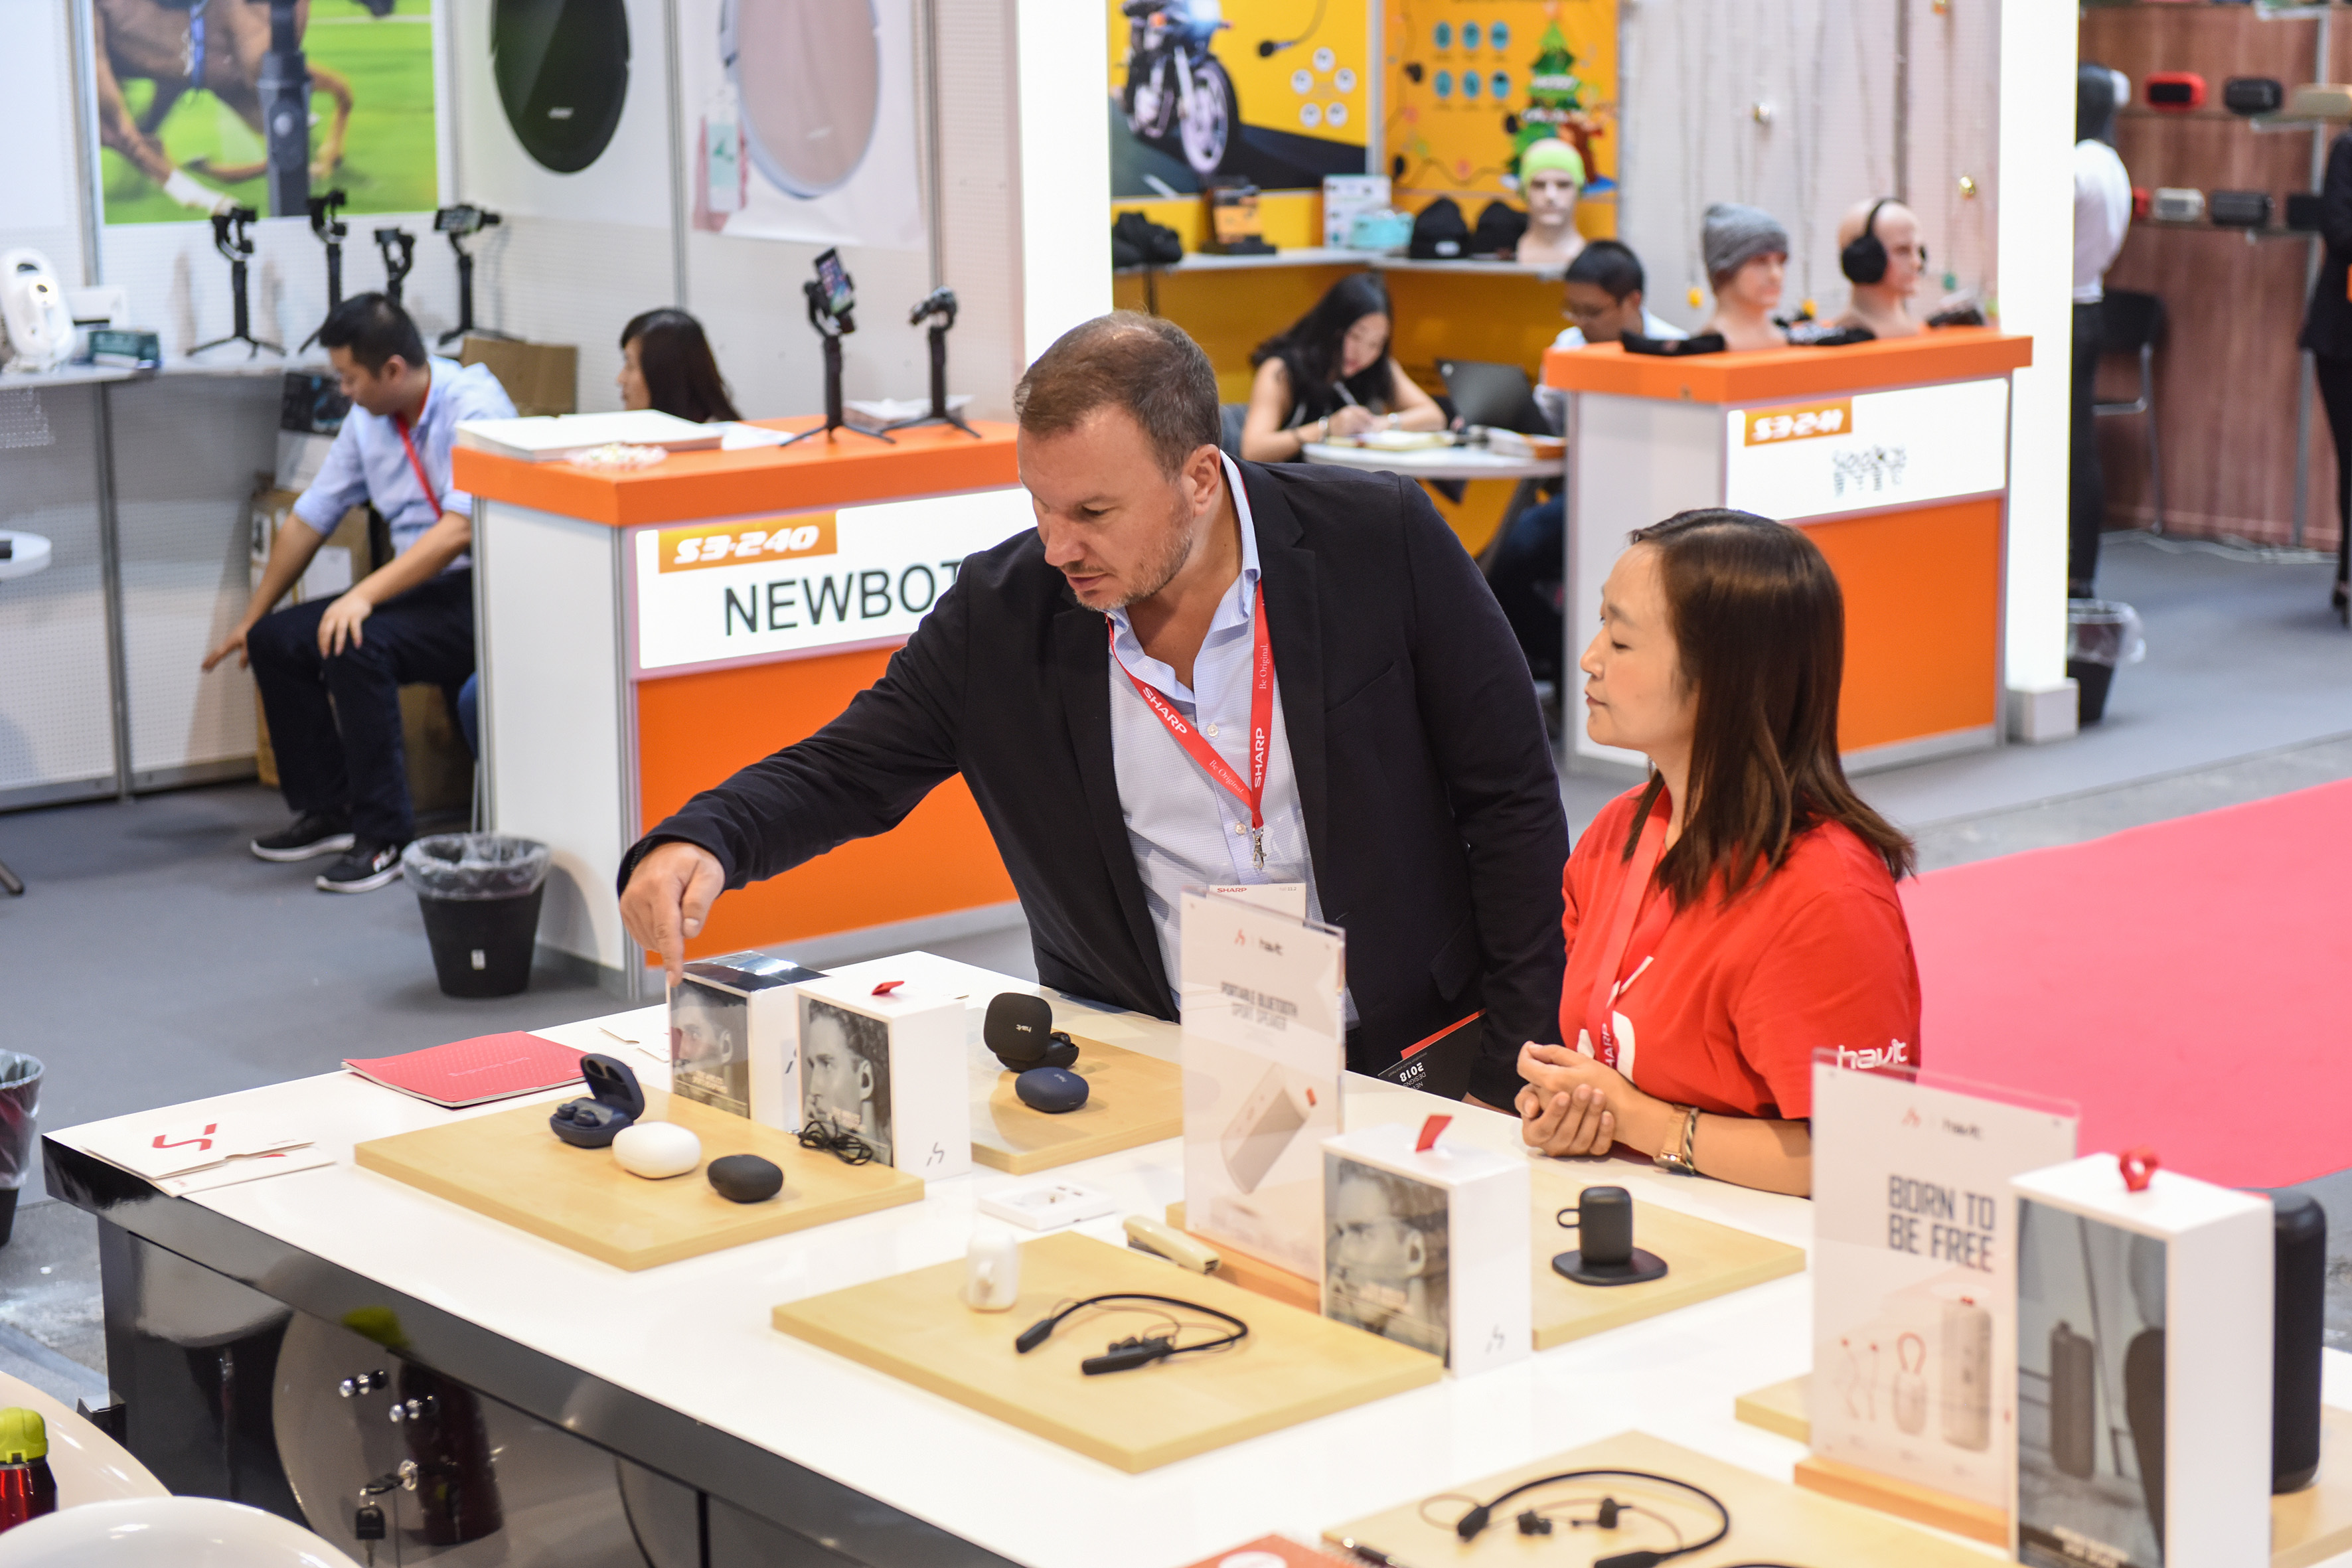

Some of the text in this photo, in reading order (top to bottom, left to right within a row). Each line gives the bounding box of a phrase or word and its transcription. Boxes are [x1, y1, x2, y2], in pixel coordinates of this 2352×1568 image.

[673, 525, 820, 565] S3-240
[724, 560, 963, 637] NEWBOT
[1259, 643, 1270, 690] Be Original.
[1142, 686, 1188, 734] SHARP
[1209, 759, 1245, 795] Be Original.
[1254, 727, 1265, 788] SHARP
[1399, 1062, 1425, 1082] 2018
[1836, 1038, 1909, 1070] havit
[1889, 1174, 1996, 1231] BORN TO
[1889, 1213, 1994, 1274] BE FREE
